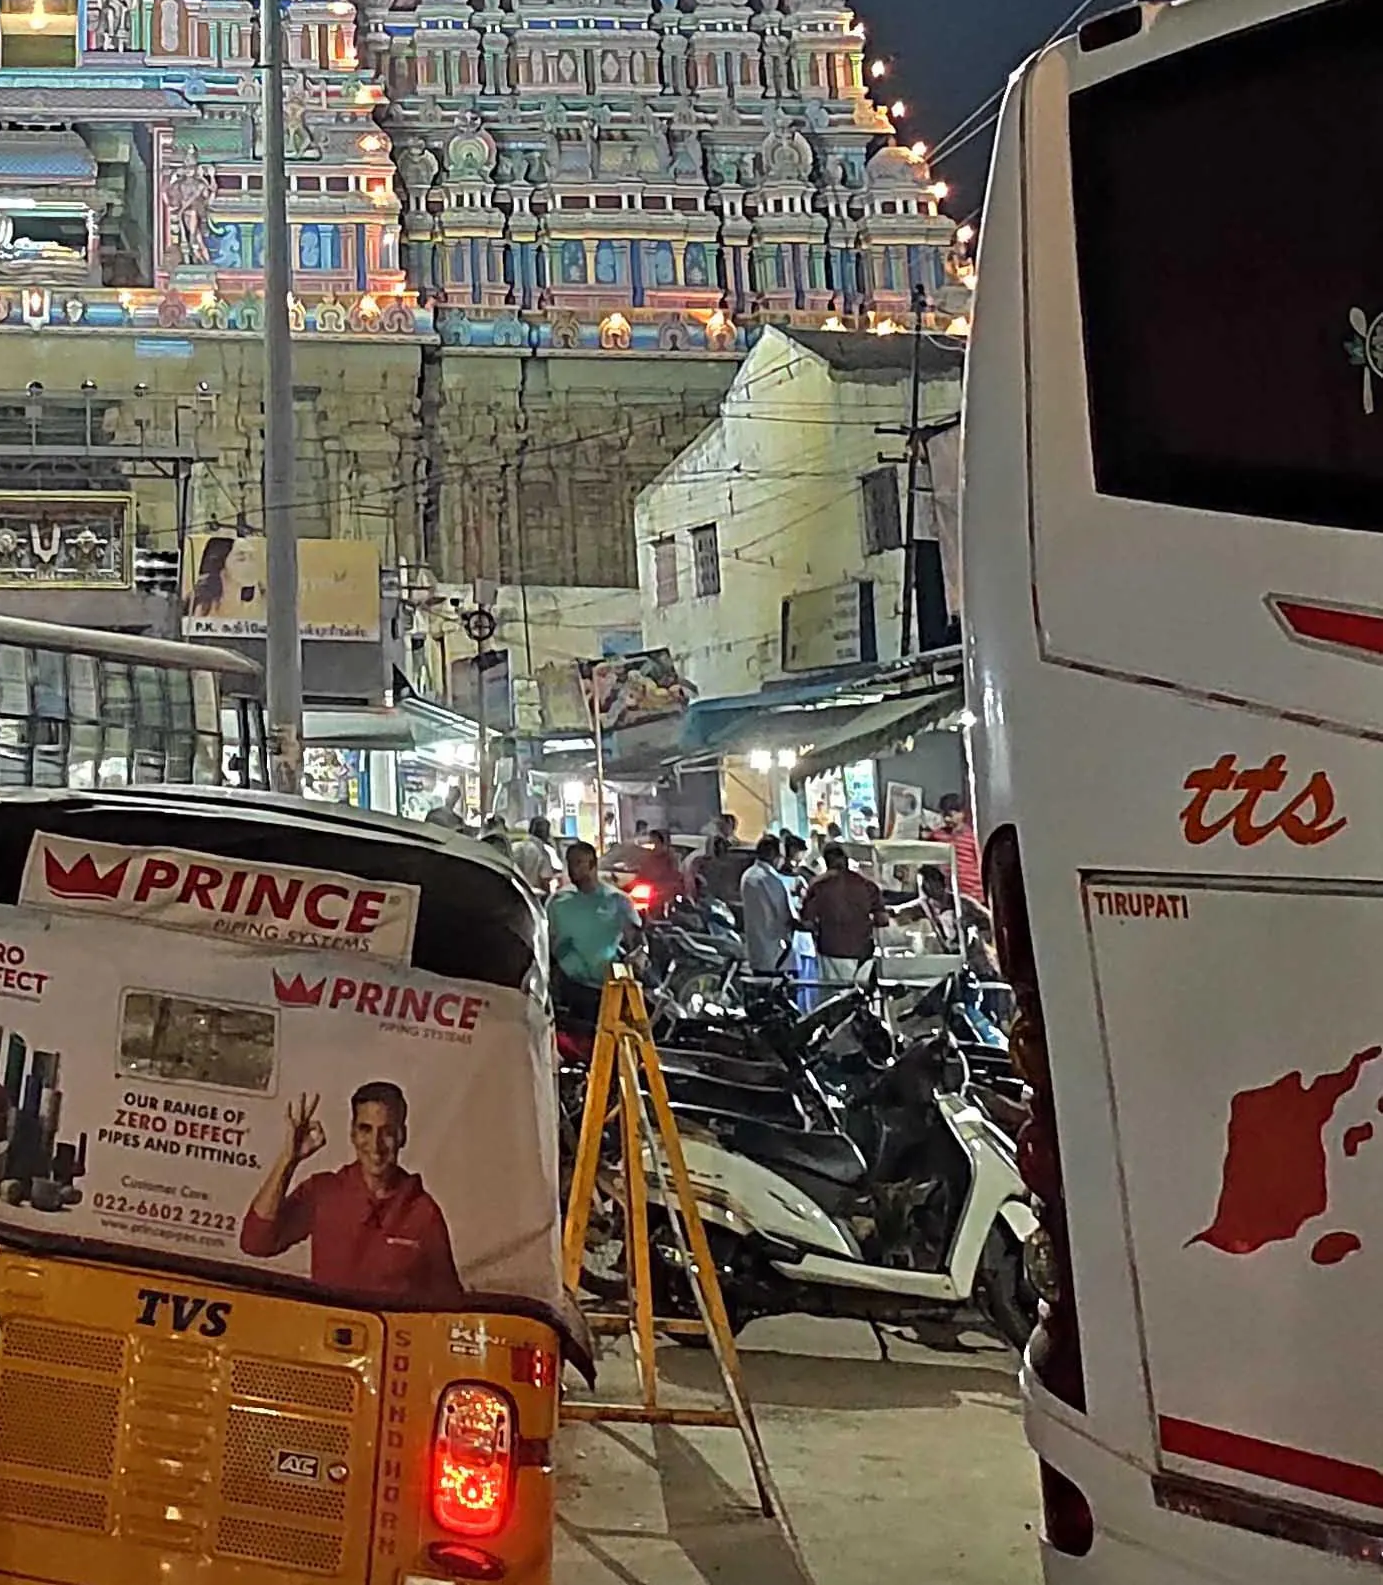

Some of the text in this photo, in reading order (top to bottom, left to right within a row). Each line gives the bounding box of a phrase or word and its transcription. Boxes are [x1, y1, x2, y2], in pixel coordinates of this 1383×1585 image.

[1179, 753, 1347, 846] tts
[133, 858, 387, 933] PRINCE
[1093, 891, 1190, 920] TIRUPATI
[287, 929, 372, 953] SYSTEMS
[329, 977, 484, 1031] PRINCE
[114, 1109, 246, 1147] ZERO DEFECT
[124, 1092, 247, 1125] OUR RANGE OF
[98, 1129, 262, 1169] PIPES AND FITTINGS.
[121, 1175, 209, 1201] Customer Care
[93, 1192, 237, 1232] 022-6602 2222
[136, 1288, 233, 1338] TVS
